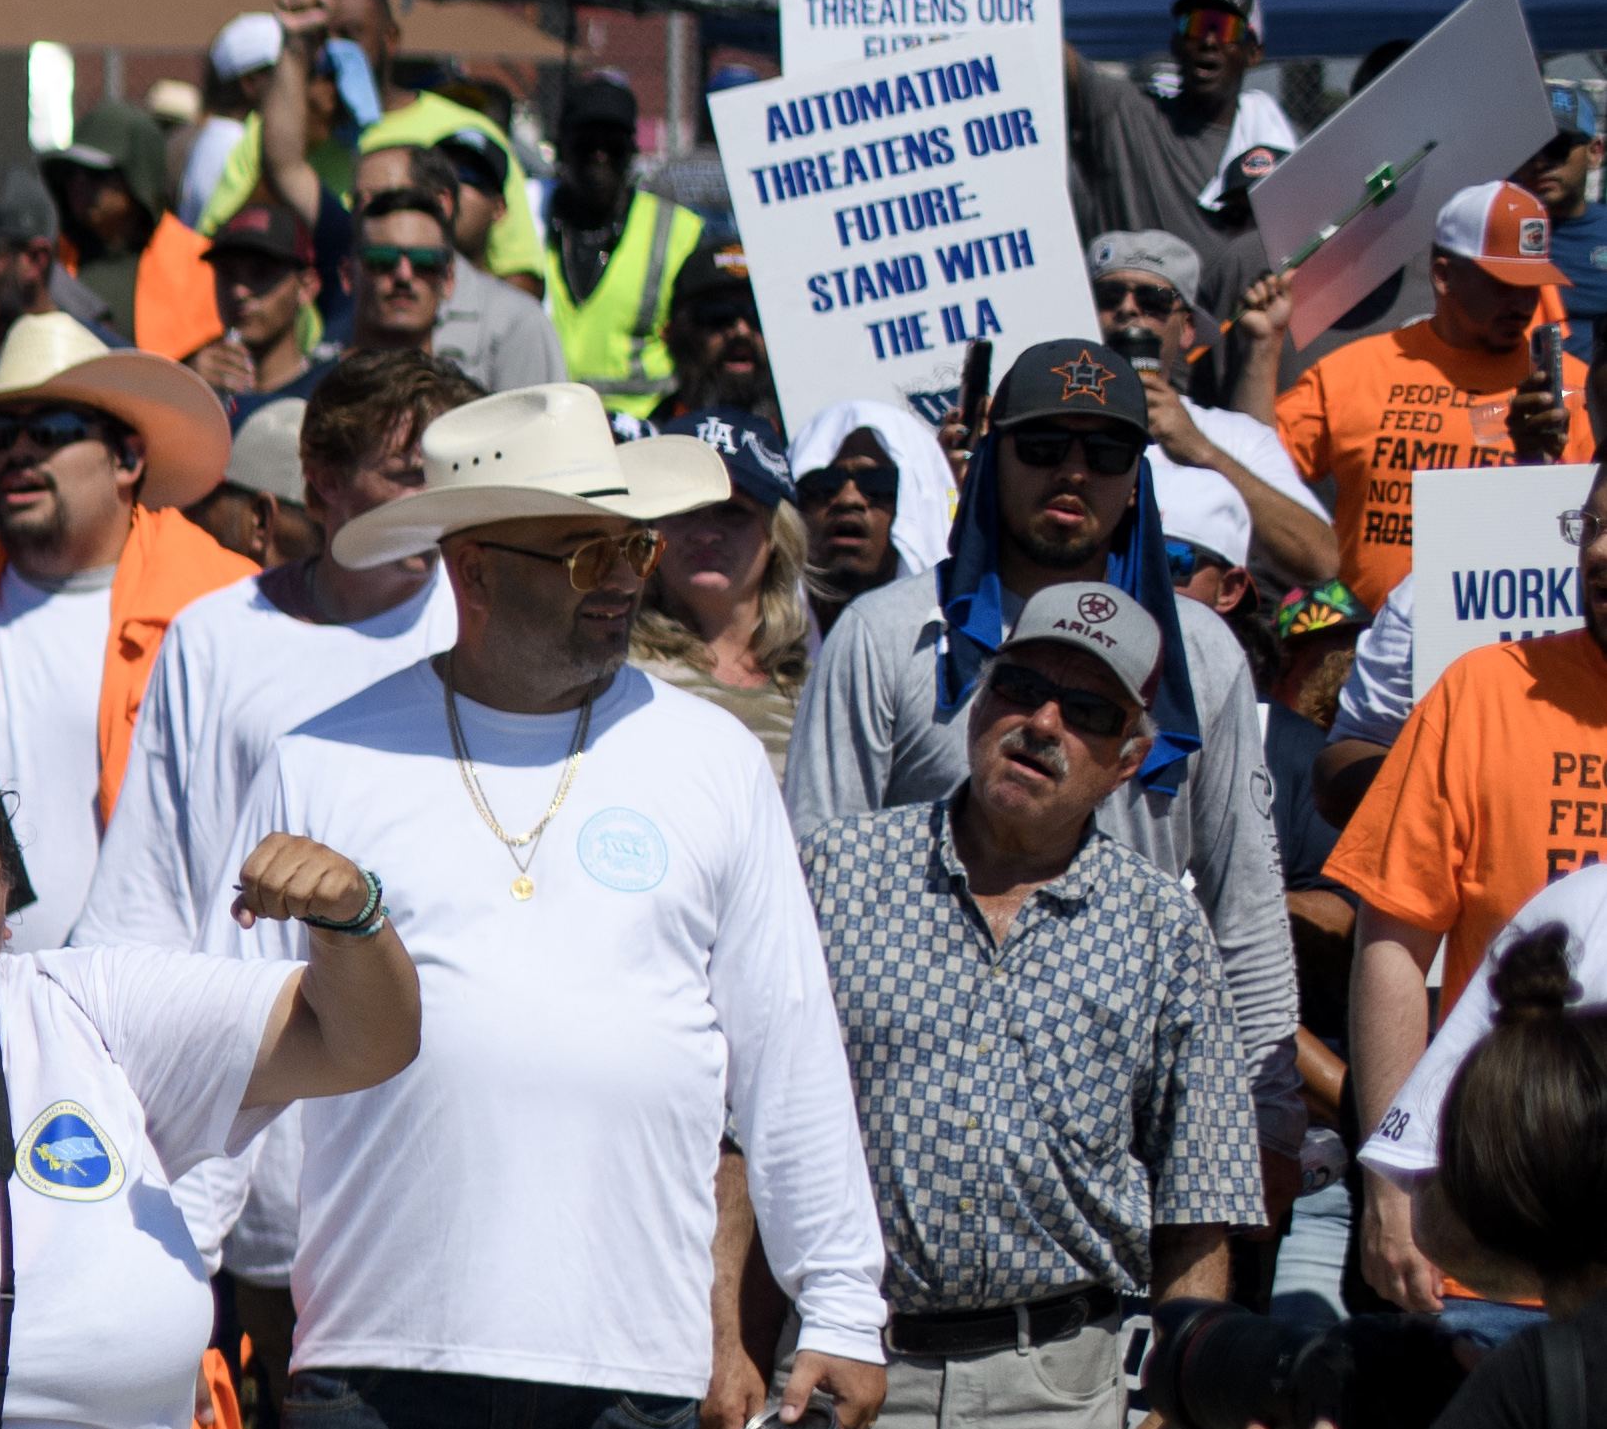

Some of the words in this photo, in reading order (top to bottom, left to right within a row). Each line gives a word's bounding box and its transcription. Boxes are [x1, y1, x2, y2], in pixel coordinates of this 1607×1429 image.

[764, 54, 1002, 145] AUTOMATION
[747, 126, 958, 207] THREATENS
[963, 108, 1040, 158] OUR
[833, 181, 982, 249] FUTURE:
[804, 252, 930, 315] STAND
[934, 228, 1036, 286] WITH
[864, 310, 935, 361] THE
[939, 297, 1004, 345] ILA
[1380, 409, 1443, 434] FEED
[1387, 383, 1479, 409] PEOPLE
[1052, 618, 1118, 650] ARIAT
